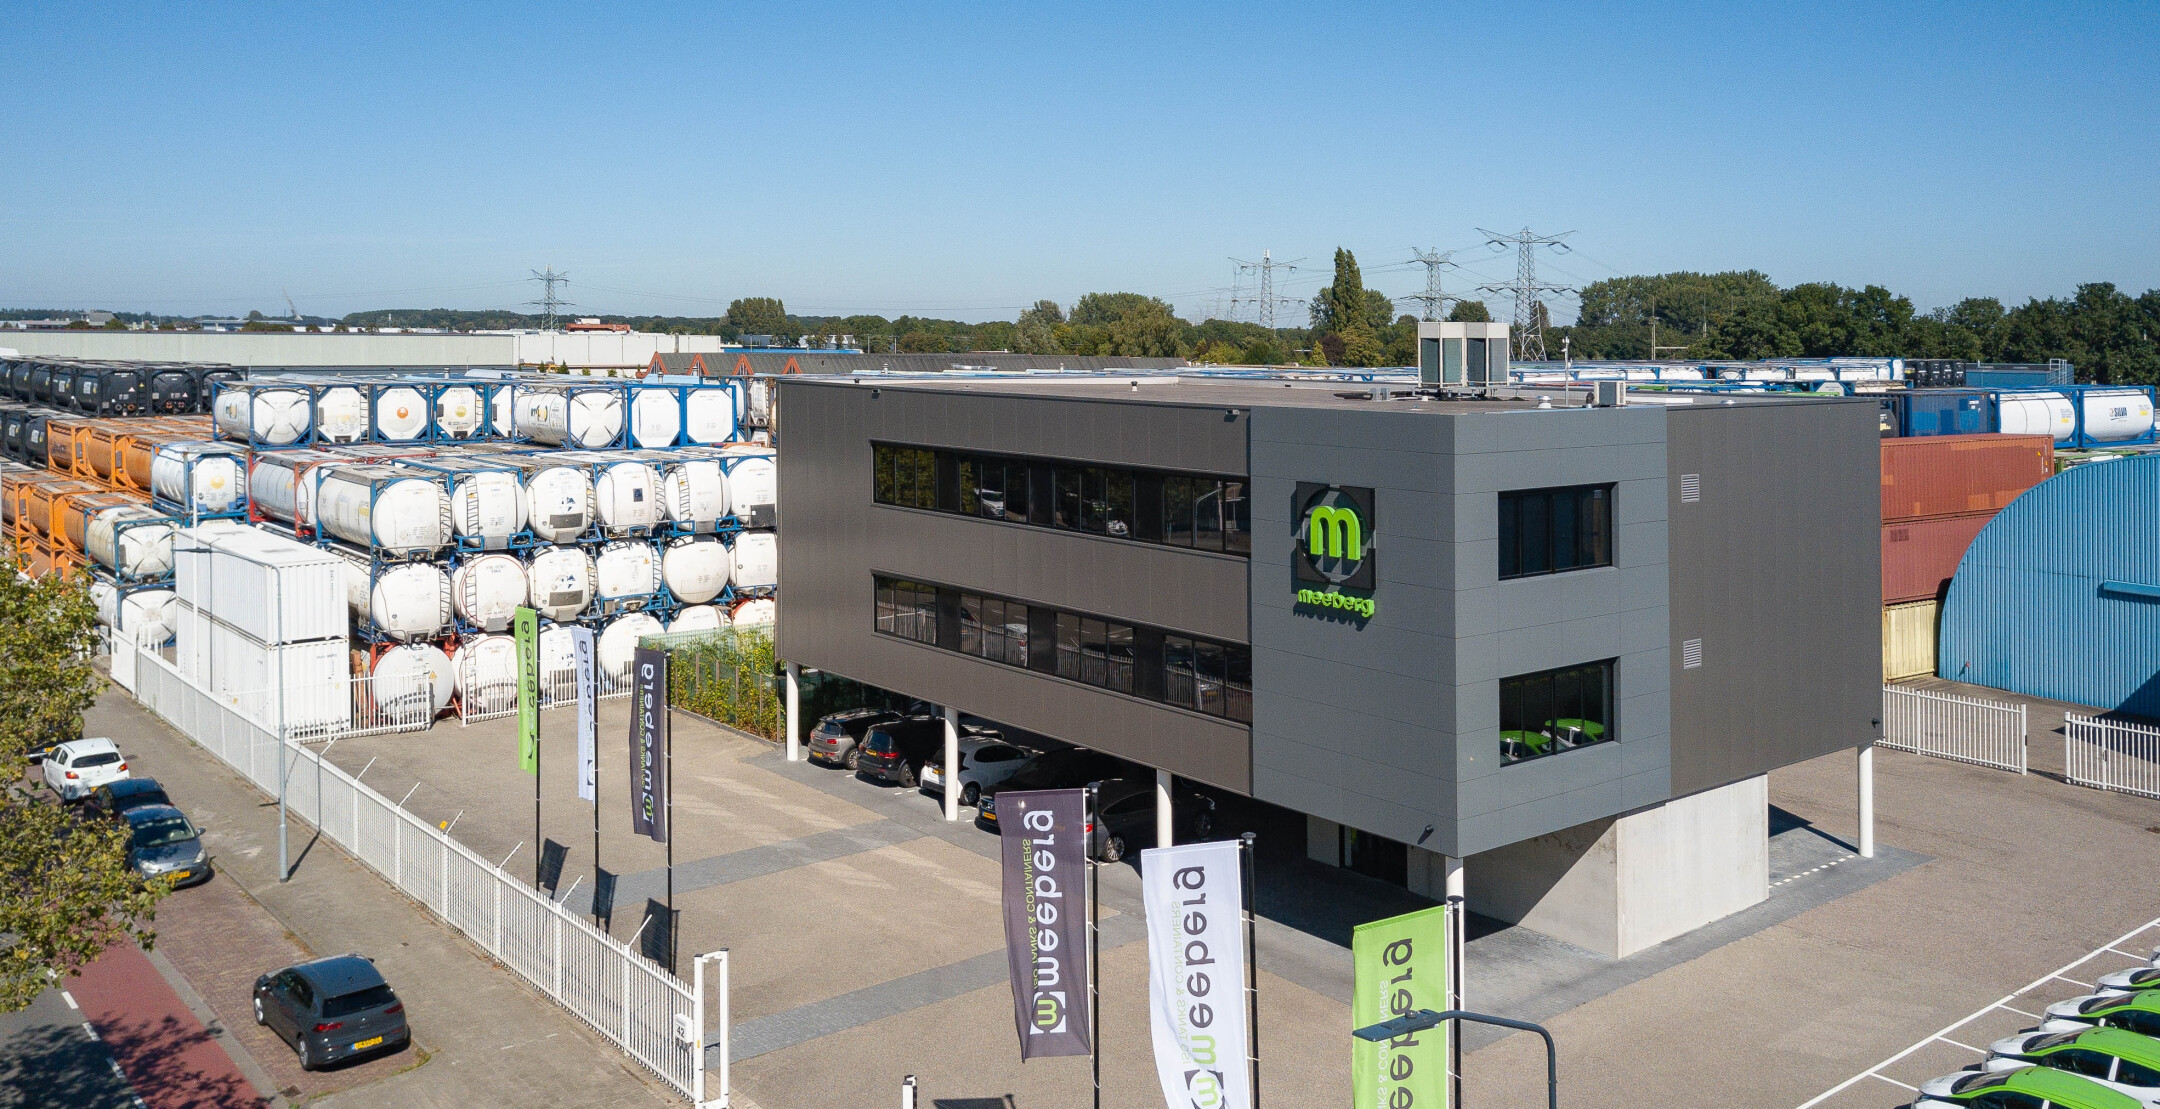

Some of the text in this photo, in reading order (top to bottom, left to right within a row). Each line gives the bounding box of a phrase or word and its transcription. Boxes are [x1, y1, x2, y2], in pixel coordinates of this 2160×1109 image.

[1310, 505, 1361, 561] m
[1298, 588, 1375, 618] meeberg
[677, 1026, 685, 1038] 42
